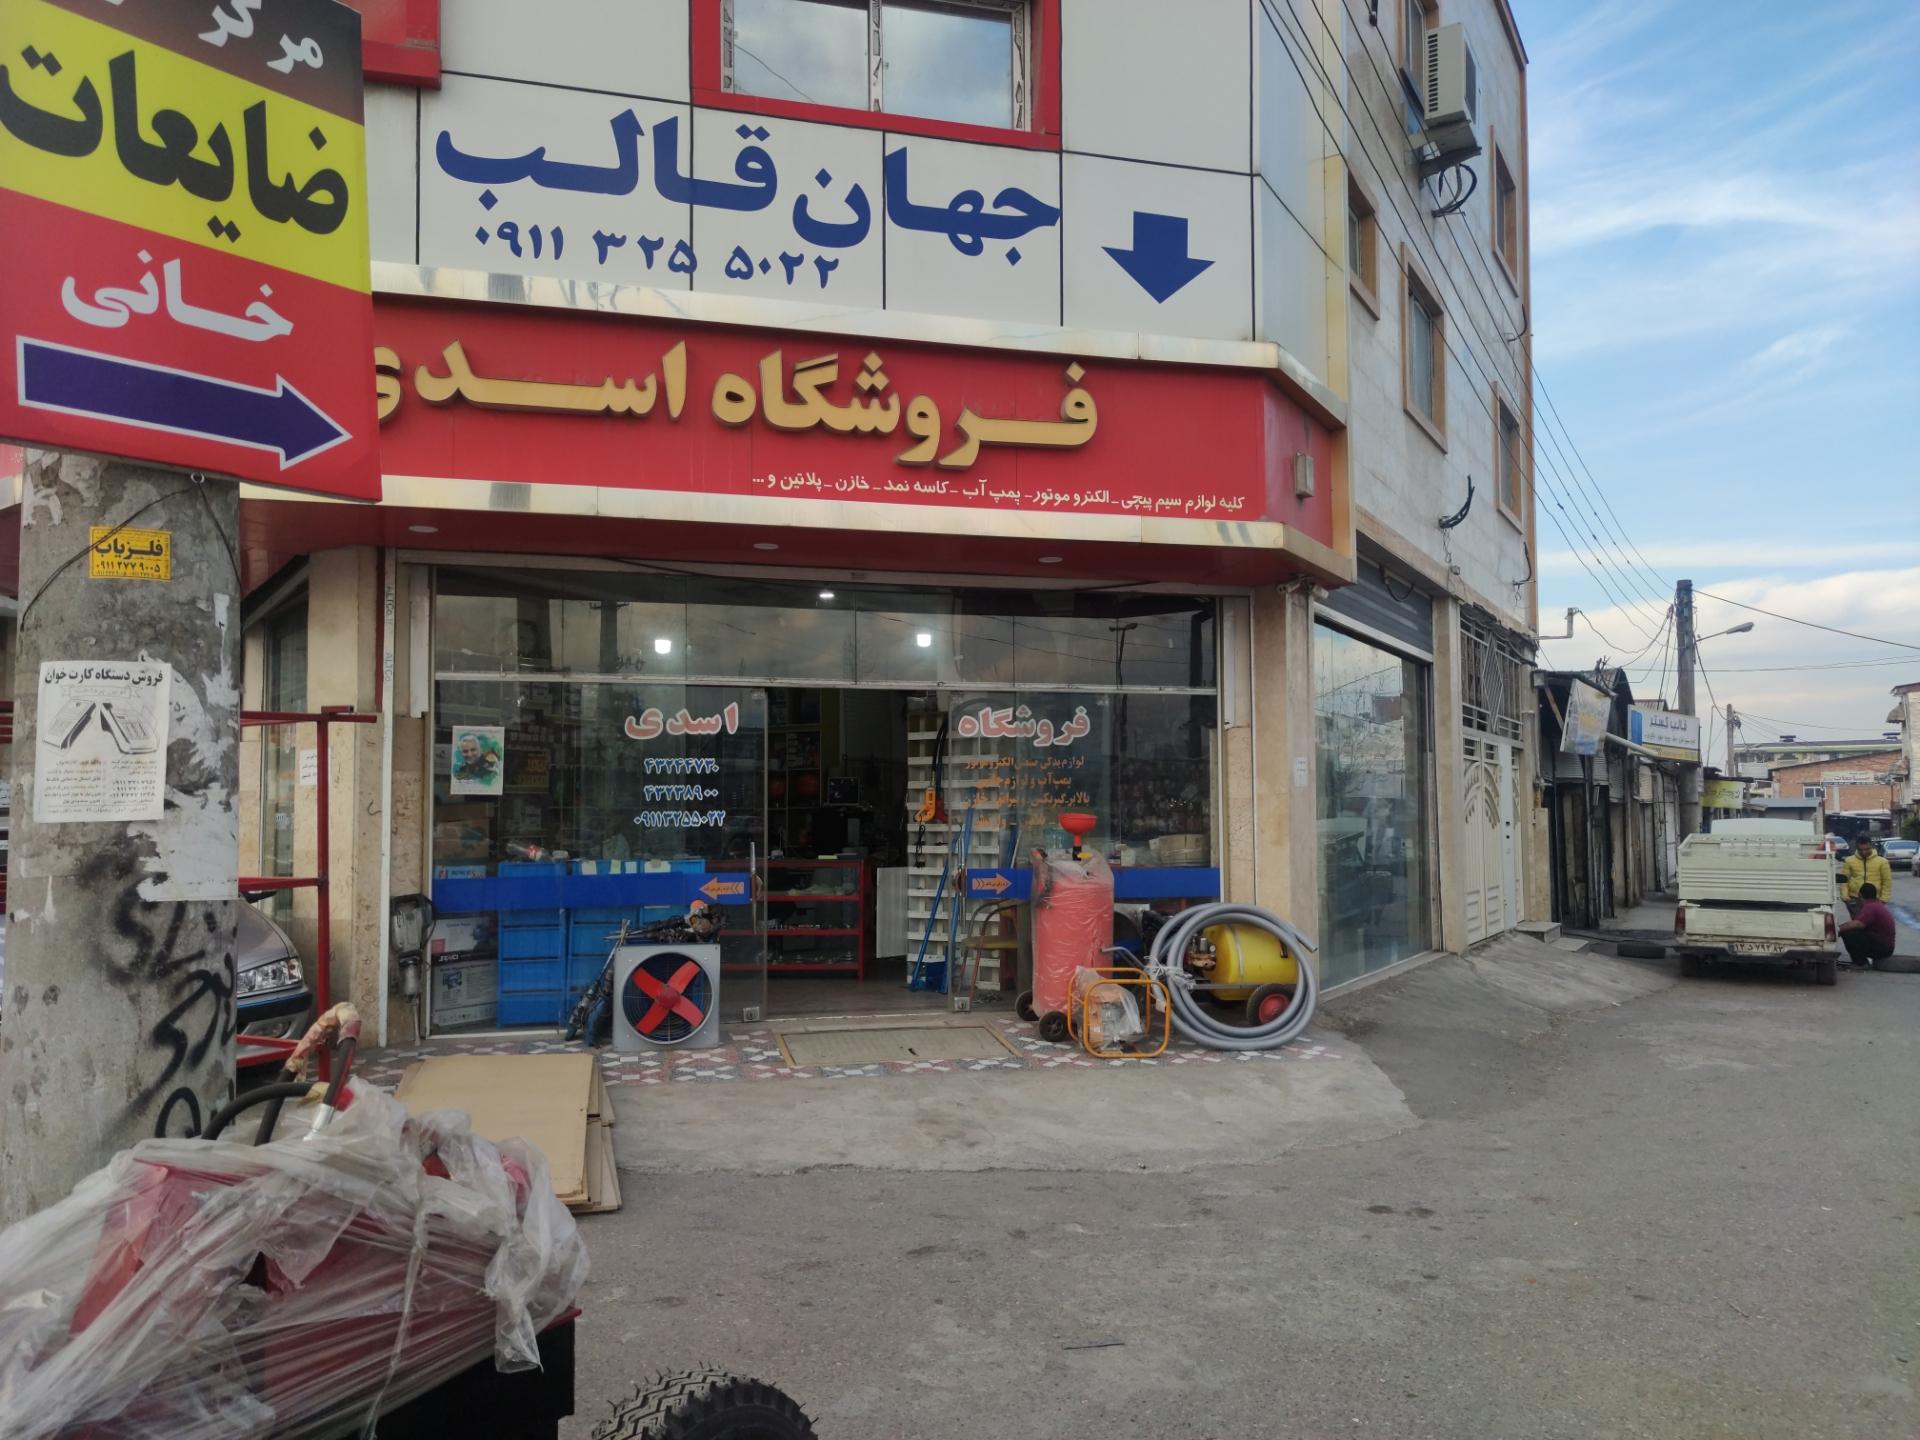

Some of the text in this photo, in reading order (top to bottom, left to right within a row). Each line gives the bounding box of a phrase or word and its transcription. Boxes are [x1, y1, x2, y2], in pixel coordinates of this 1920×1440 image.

[0, 45, 349, 243] ضایعات
[436, 108, 1061, 266] جهان قالب
[475, 221, 839, 289] ۰۹۱۱ ۳۲۵ ۵۰۲۲
[61, 248, 294, 342] خانی
[711, 350, 1098, 468] فروشگاه
[780, 471, 822, 493] پلاتین
[835, 474, 870, 492] خازن
[884, 479, 910, 493] نمد
[913, 480, 950, 495] کاسه
[962, 478, 987, 500] آب
[989, 487, 1021, 507] پمپ
[1121, 495, 1153, 512] پیچی
[1155, 496, 1182, 513] سیم
[1184, 495, 1216, 514] لوازم
[1219, 495, 1245, 512] کلیه
[95, 538, 164, 560] فلزیاب
[44, 667, 164, 686] فروش دستگاه کارت خوان
[625, 701, 739, 739] اسدی
[958, 704, 1091, 747] فروشگاه
